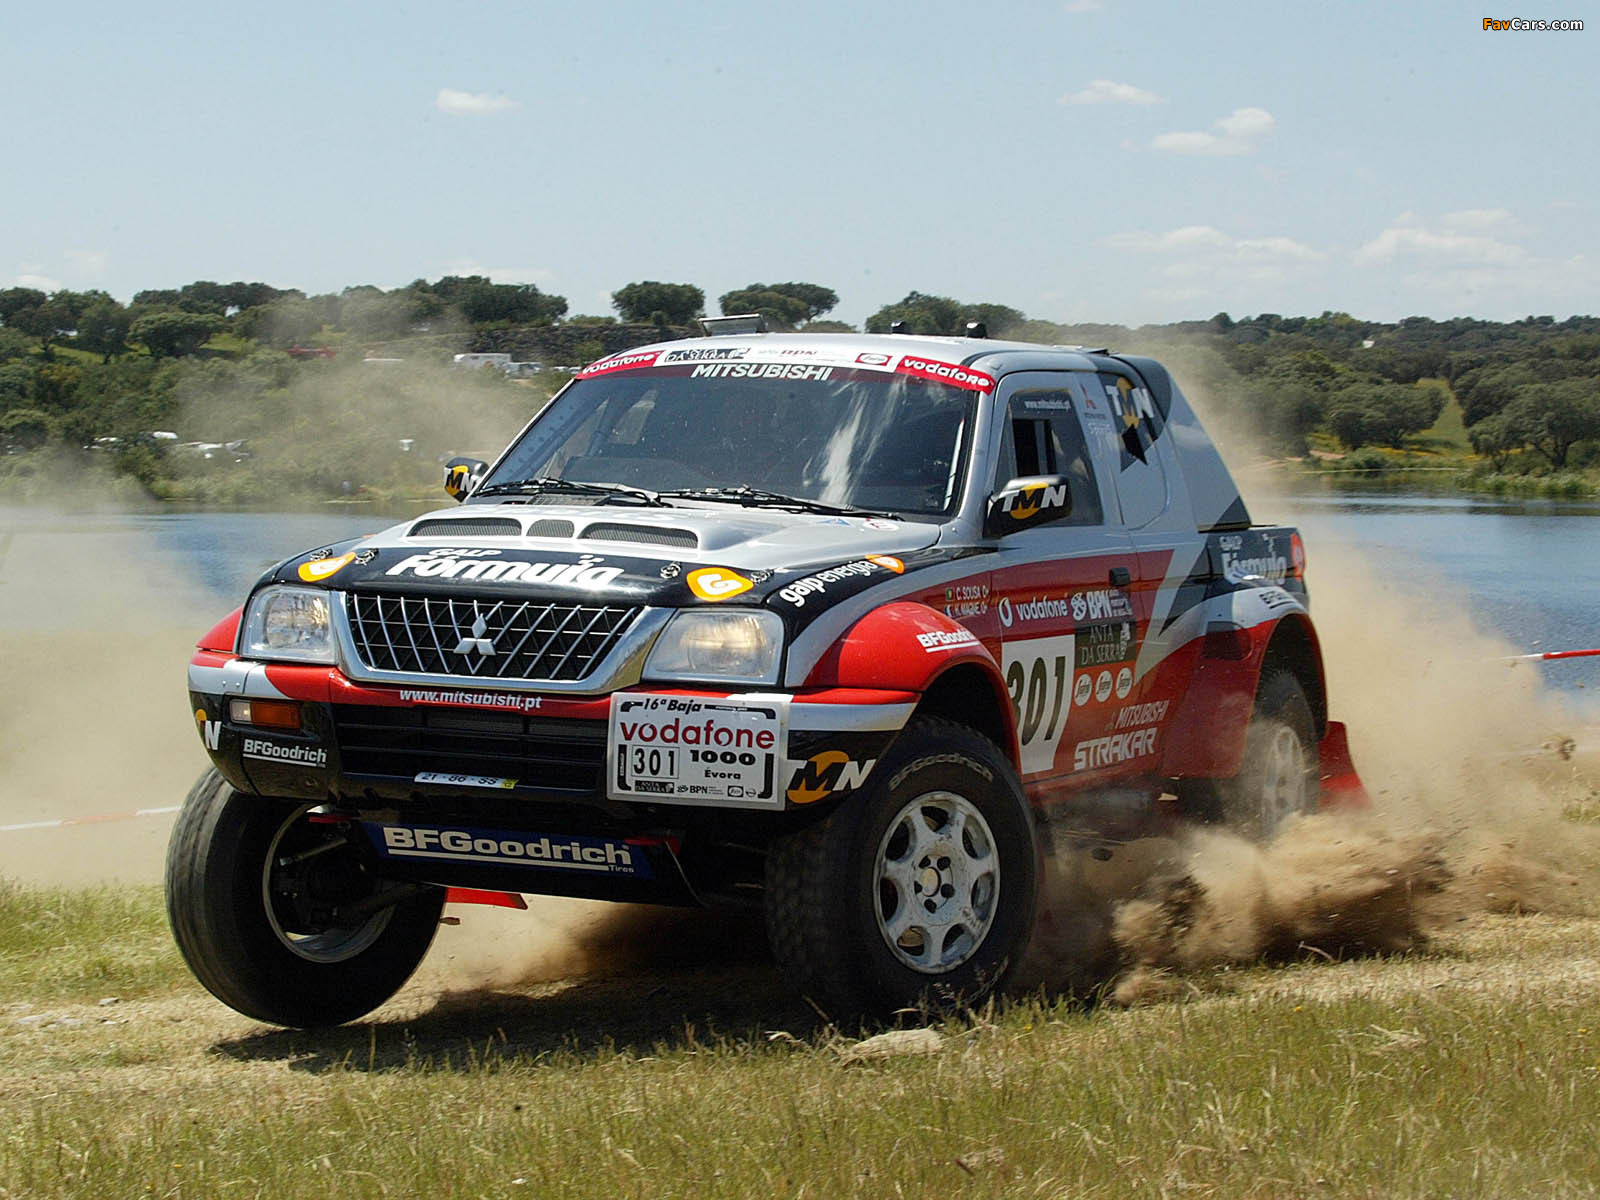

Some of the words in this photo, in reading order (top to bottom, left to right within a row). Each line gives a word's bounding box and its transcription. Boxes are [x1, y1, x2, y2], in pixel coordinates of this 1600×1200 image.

[691, 363, 833, 382] MITSUBISHI
[904, 358, 990, 387] vodafone
[999, 485, 1067, 514] TMN
[428, 548, 503, 558] GALP
[1016, 596, 1068, 622] vodafone
[1086, 590, 1113, 619] BPN
[399, 689, 543, 712] www.mitsubishi.pt
[668, 699, 702, 715] Baja
[1004, 656, 1065, 746] 301
[1115, 699, 1170, 729] MITSUBISHI
[620, 718, 775, 750] vodafone
[243, 739, 328, 763] BFGoodrich
[633, 747, 675, 776] 301
[690, 749, 756, 766] 1000
[1074, 727, 1158, 771] STRAKAR
[704, 767, 742, 780] Évora
[690, 785, 708, 795] BPN
[383, 826, 632, 865] BFGoodrich
